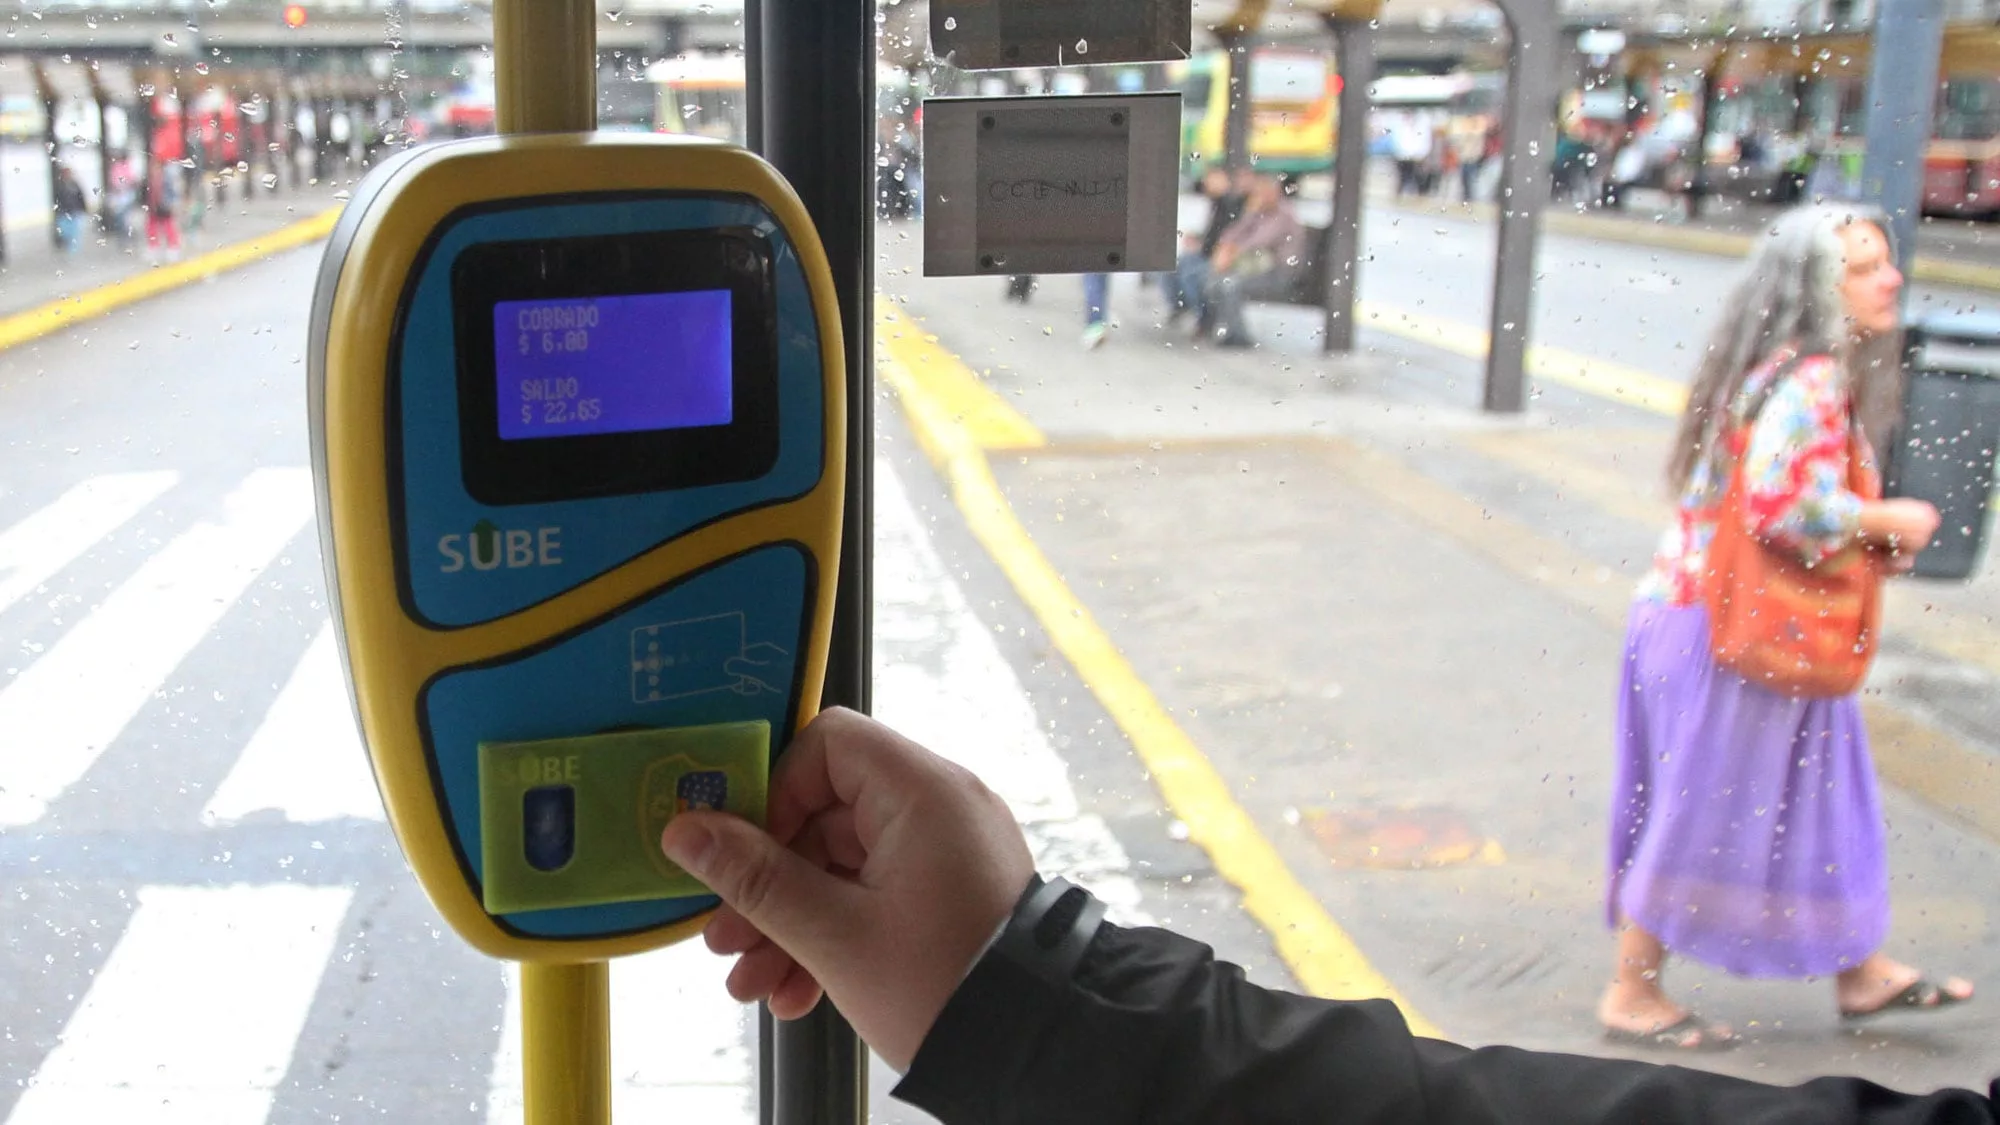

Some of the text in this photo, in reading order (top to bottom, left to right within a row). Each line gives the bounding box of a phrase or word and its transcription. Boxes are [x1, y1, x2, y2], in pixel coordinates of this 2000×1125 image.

[518, 305, 599, 330] COBRADO
[520, 377, 578, 401] SALDO
[437, 526, 563, 573] SUBE
